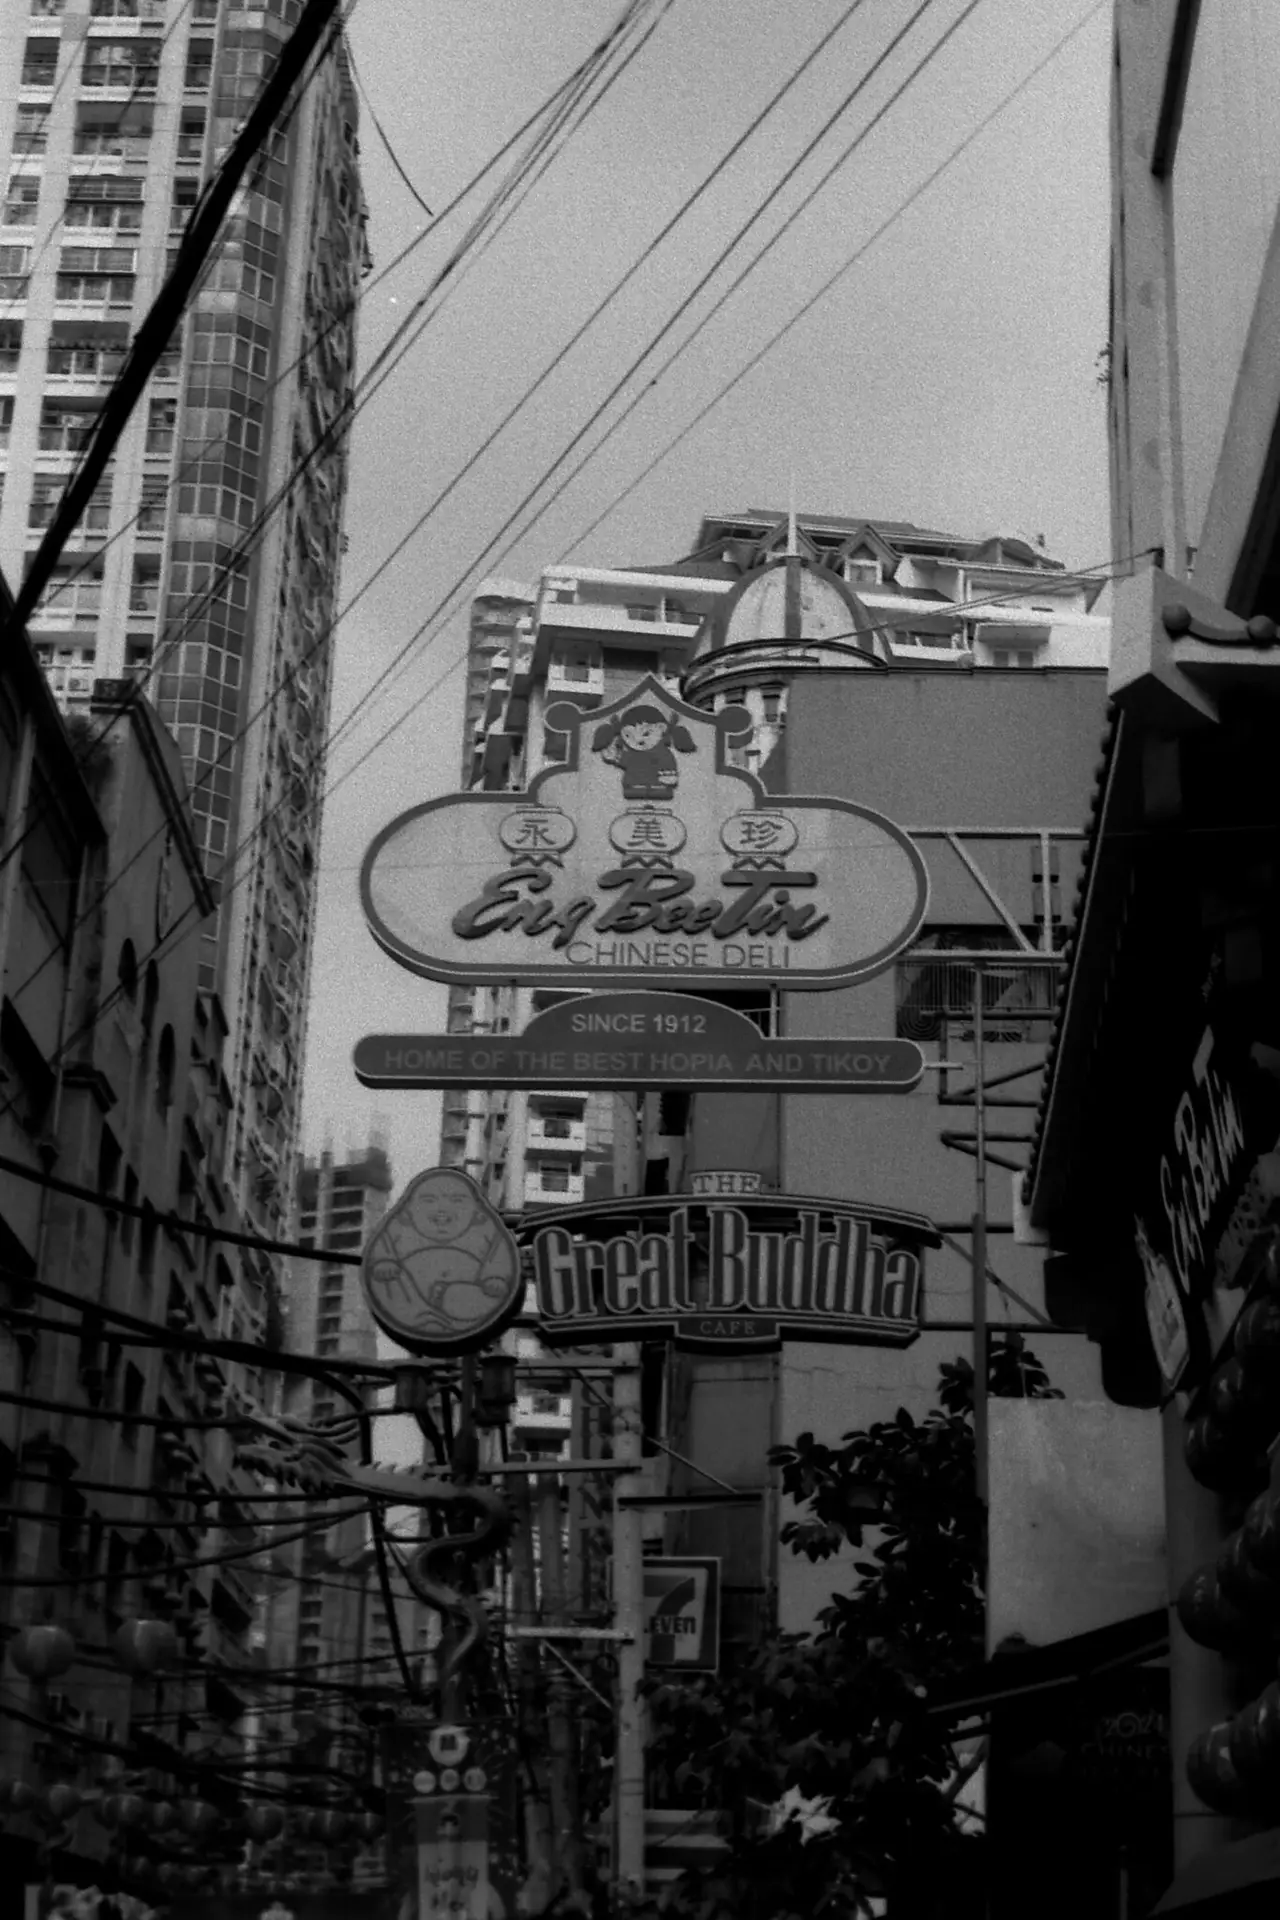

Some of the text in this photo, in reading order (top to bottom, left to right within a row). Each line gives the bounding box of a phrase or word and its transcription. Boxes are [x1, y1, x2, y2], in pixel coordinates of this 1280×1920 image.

[515, 816, 784, 850] 永 美 珍
[452, 867, 830, 950] Eng Bee Tin
[565, 940, 790, 968] CHINESE DELI
[571, 1013, 707, 1034] SINCE 1912
[384, 1050, 891, 1074] HOME OF THE BEST HOPIA AND TIKOY
[693, 1175, 758, 1194] THE
[533, 1205, 920, 1321] Great Buddha
[700, 1320, 756, 1335] CAFE
